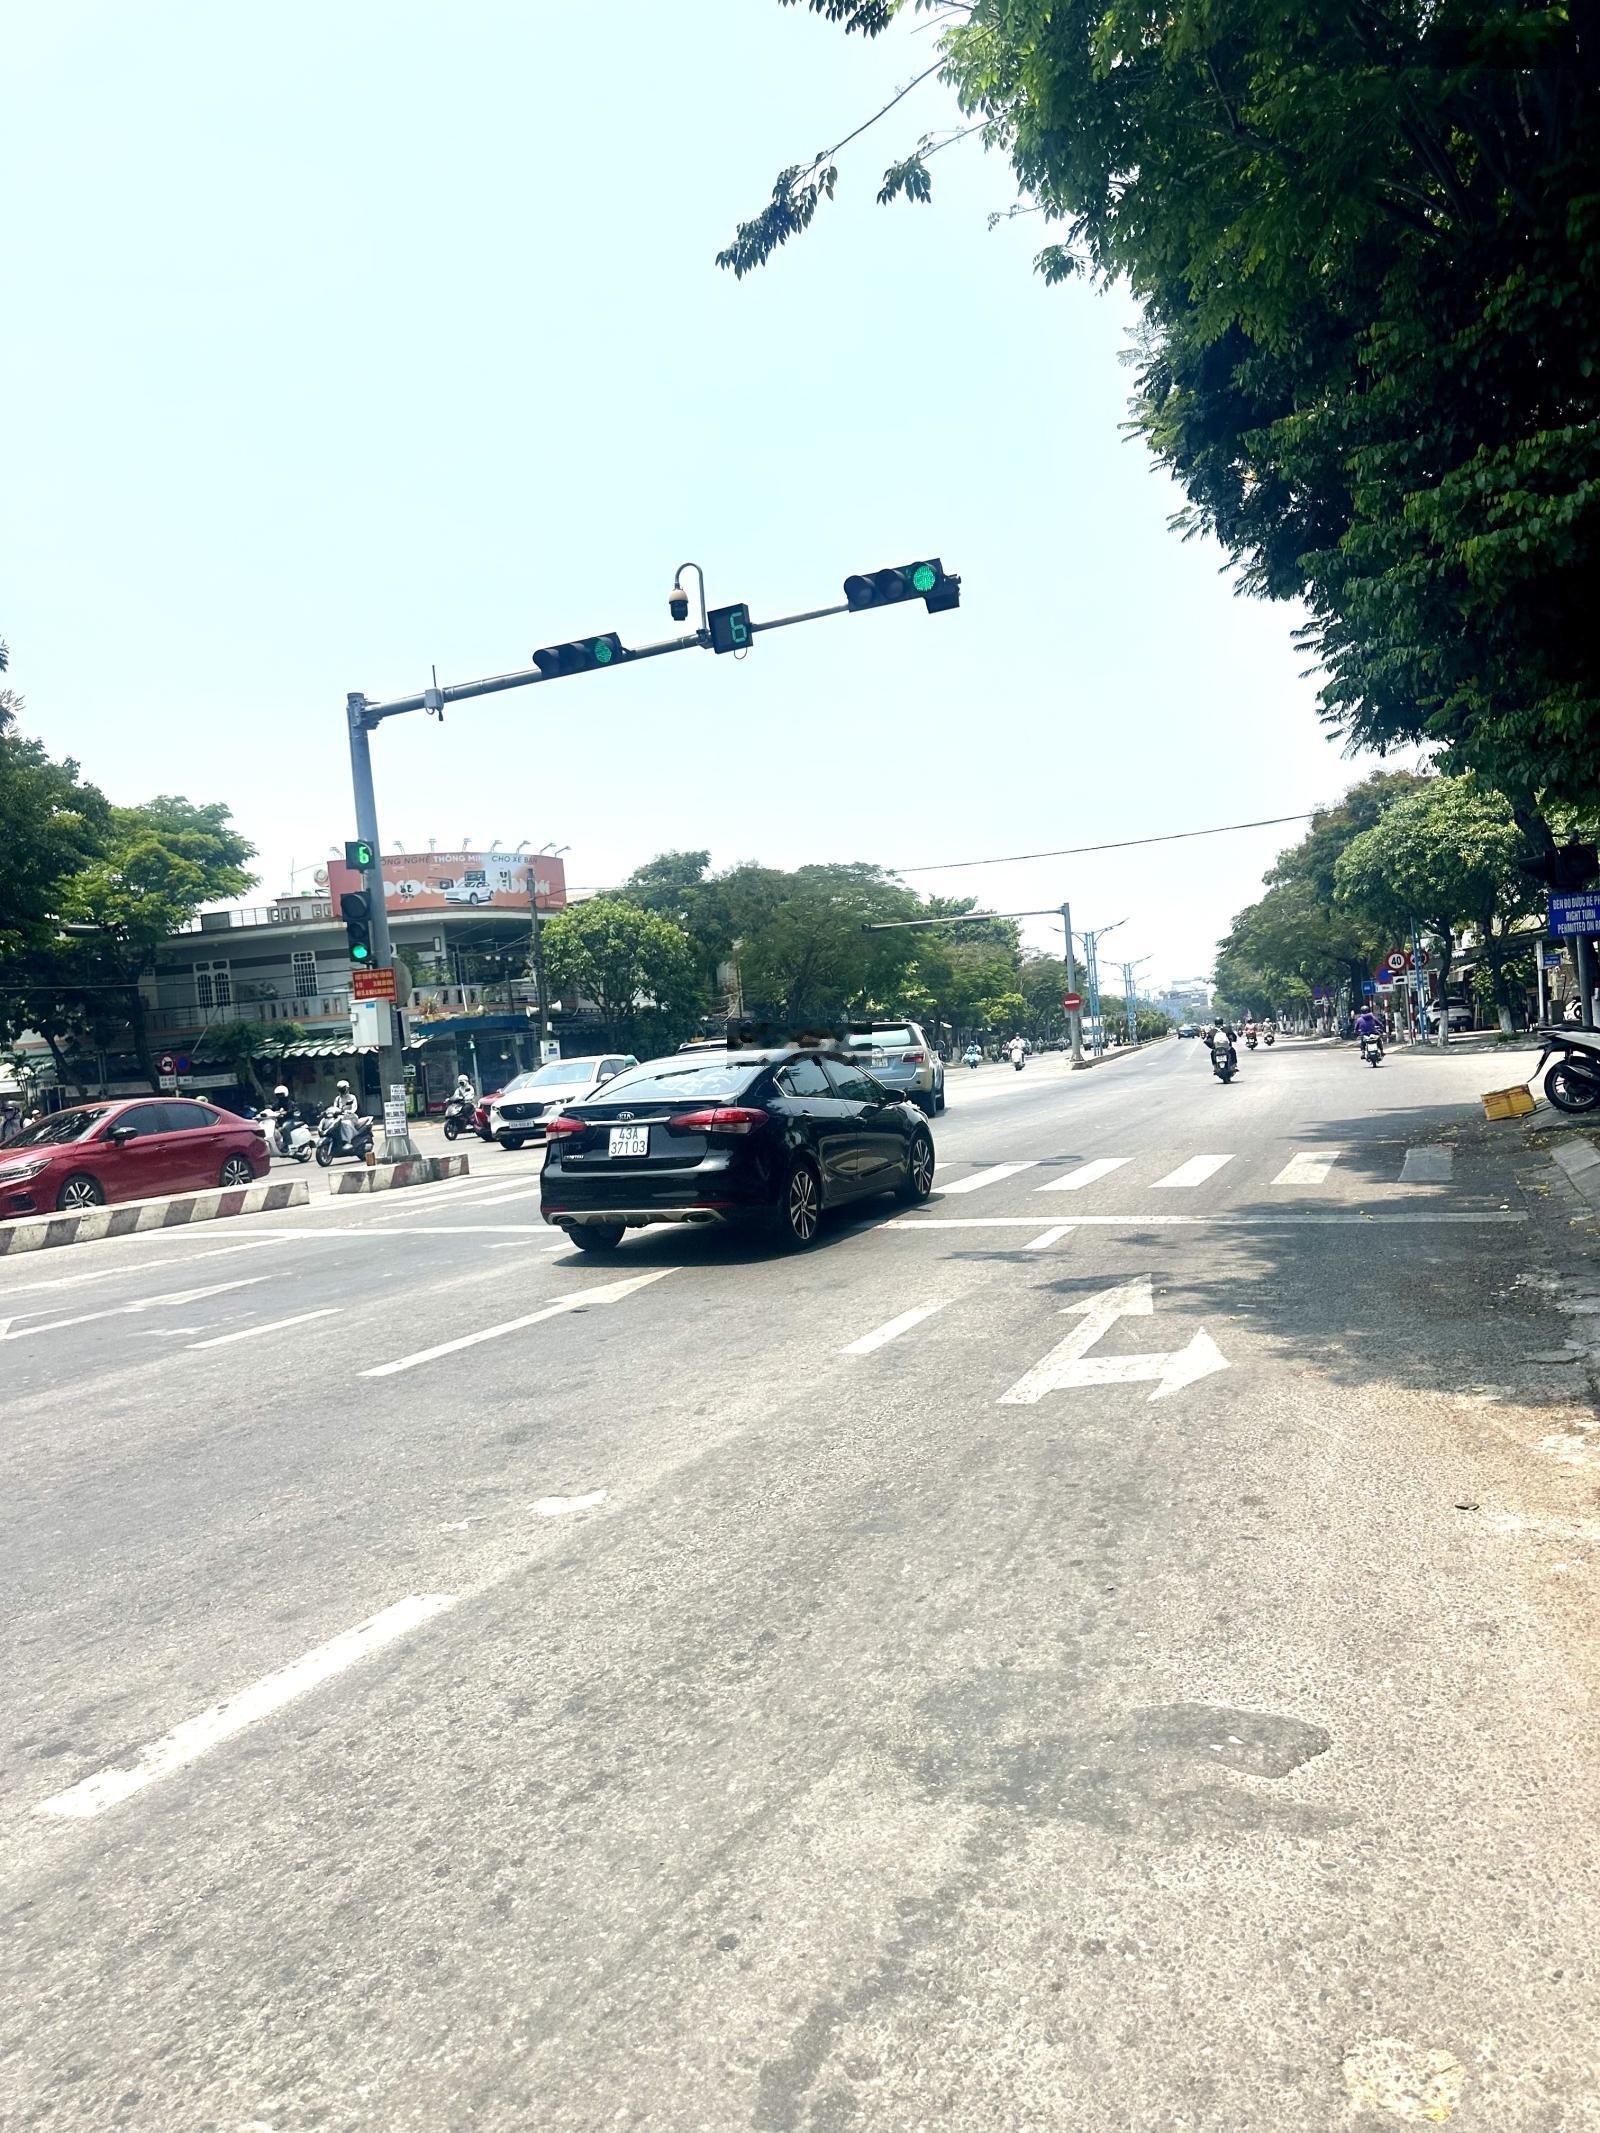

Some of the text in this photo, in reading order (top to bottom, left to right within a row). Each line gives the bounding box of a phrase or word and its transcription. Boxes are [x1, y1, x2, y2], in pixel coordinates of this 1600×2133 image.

[730, 611, 748, 643] 6
[359, 846, 370, 864] 6
[491, 855, 511, 863] CHO
[1565, 909, 1595, 920] RIGHT TURN
[1557, 921, 1585, 933] PERMITTED
[1587, 921, 1594, 930] ON
[1391, 956, 1402, 966] 40
[619, 1127, 638, 1140] 43A
[610, 1140, 646, 1155] 371 03
